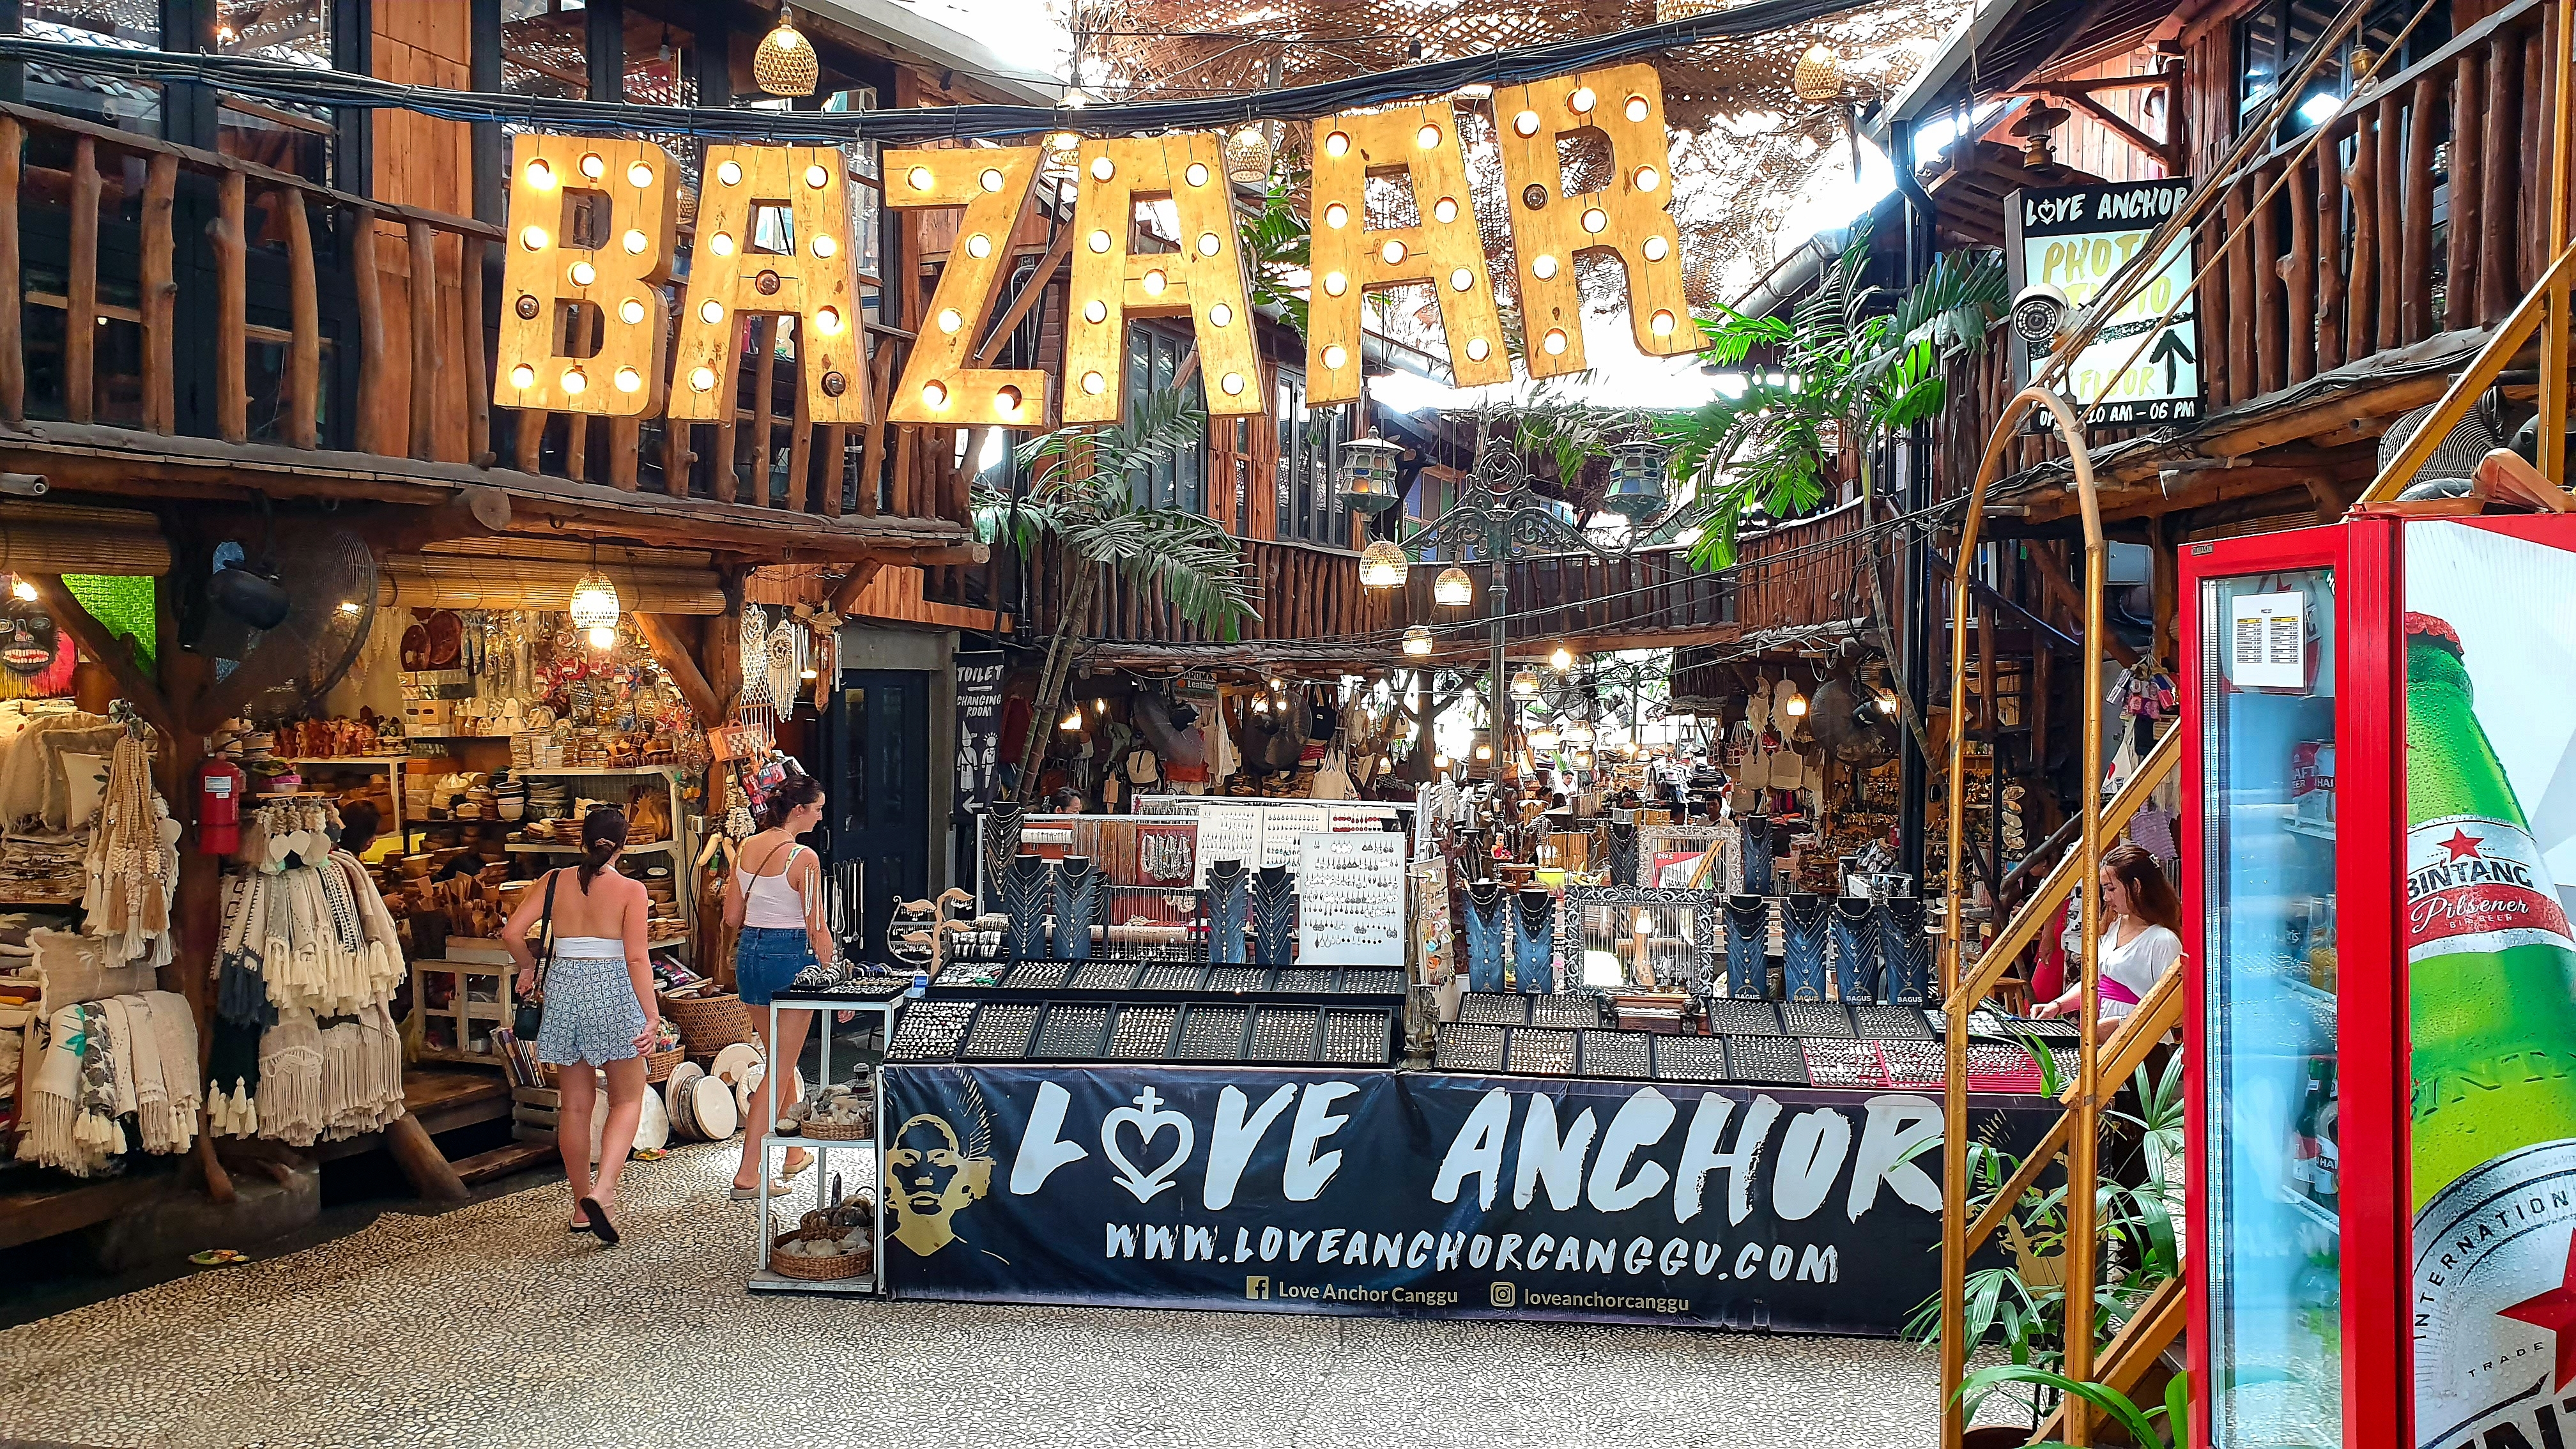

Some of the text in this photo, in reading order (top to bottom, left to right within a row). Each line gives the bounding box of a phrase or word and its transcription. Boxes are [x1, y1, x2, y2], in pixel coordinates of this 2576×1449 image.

[2097, 187, 2188, 220] ANCHOR
[493, 63, 1715, 427] BAZAAR
[2043, 233, 2159, 283] PHOT
[2109, 404, 2133, 422] AM
[2149, 401, 2169, 419] 06
[2174, 401, 2195, 418] PM
[957, 664, 1004, 682] TOILET
[1187, 680, 1215, 690] Leather
[957, 694, 1002, 706] CHANGING
[966, 706, 992, 717] ROOM
[2407, 861, 2534, 899] BINTANG
[2411, 894, 2530, 934] Pilsener
[2450, 917, 2474, 928] BIR
[1430, 1084, 1945, 1227] ANCHOR
[1105, 1221, 1839, 1284] WWW.LOVEANCHORCANGGU.COM
[1278, 1281, 1458, 1305] Love Anchor Canggu
[1524, 1288, 1690, 1312] loveanchorcanggu
[2468, 1341, 2545, 1378] TRADE
